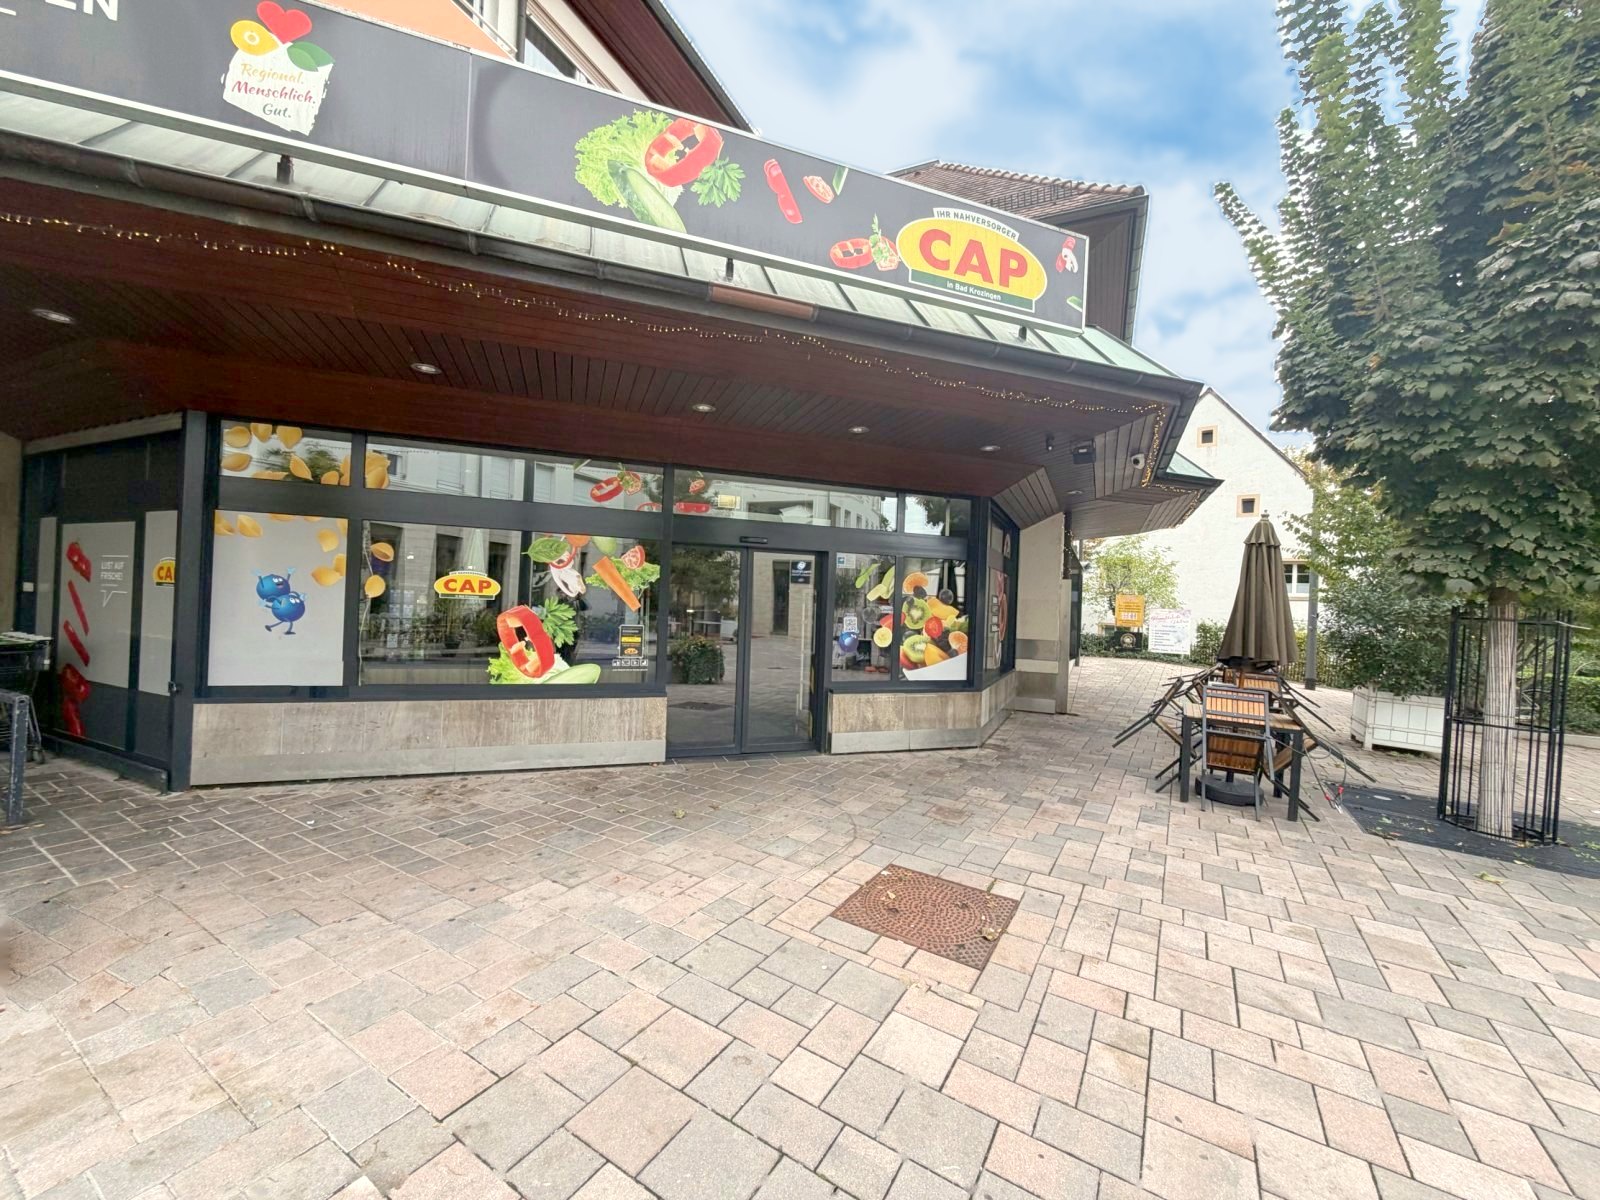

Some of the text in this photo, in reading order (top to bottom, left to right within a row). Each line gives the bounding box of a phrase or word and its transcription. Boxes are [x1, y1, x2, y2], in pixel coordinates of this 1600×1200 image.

[241, 63, 304, 84] Regional.
[231, 80, 316, 104] Menschlich.
[262, 103, 292, 118] Gut.
[936, 210, 1017, 240] IHR NAHVERSORGER
[919, 229, 1028, 288] CAP
[955, 282, 968, 292] Bad
[969, 285, 1002, 301] Krozingen
[157, 566, 174, 581] CA
[443, 578, 492, 593] CAP
